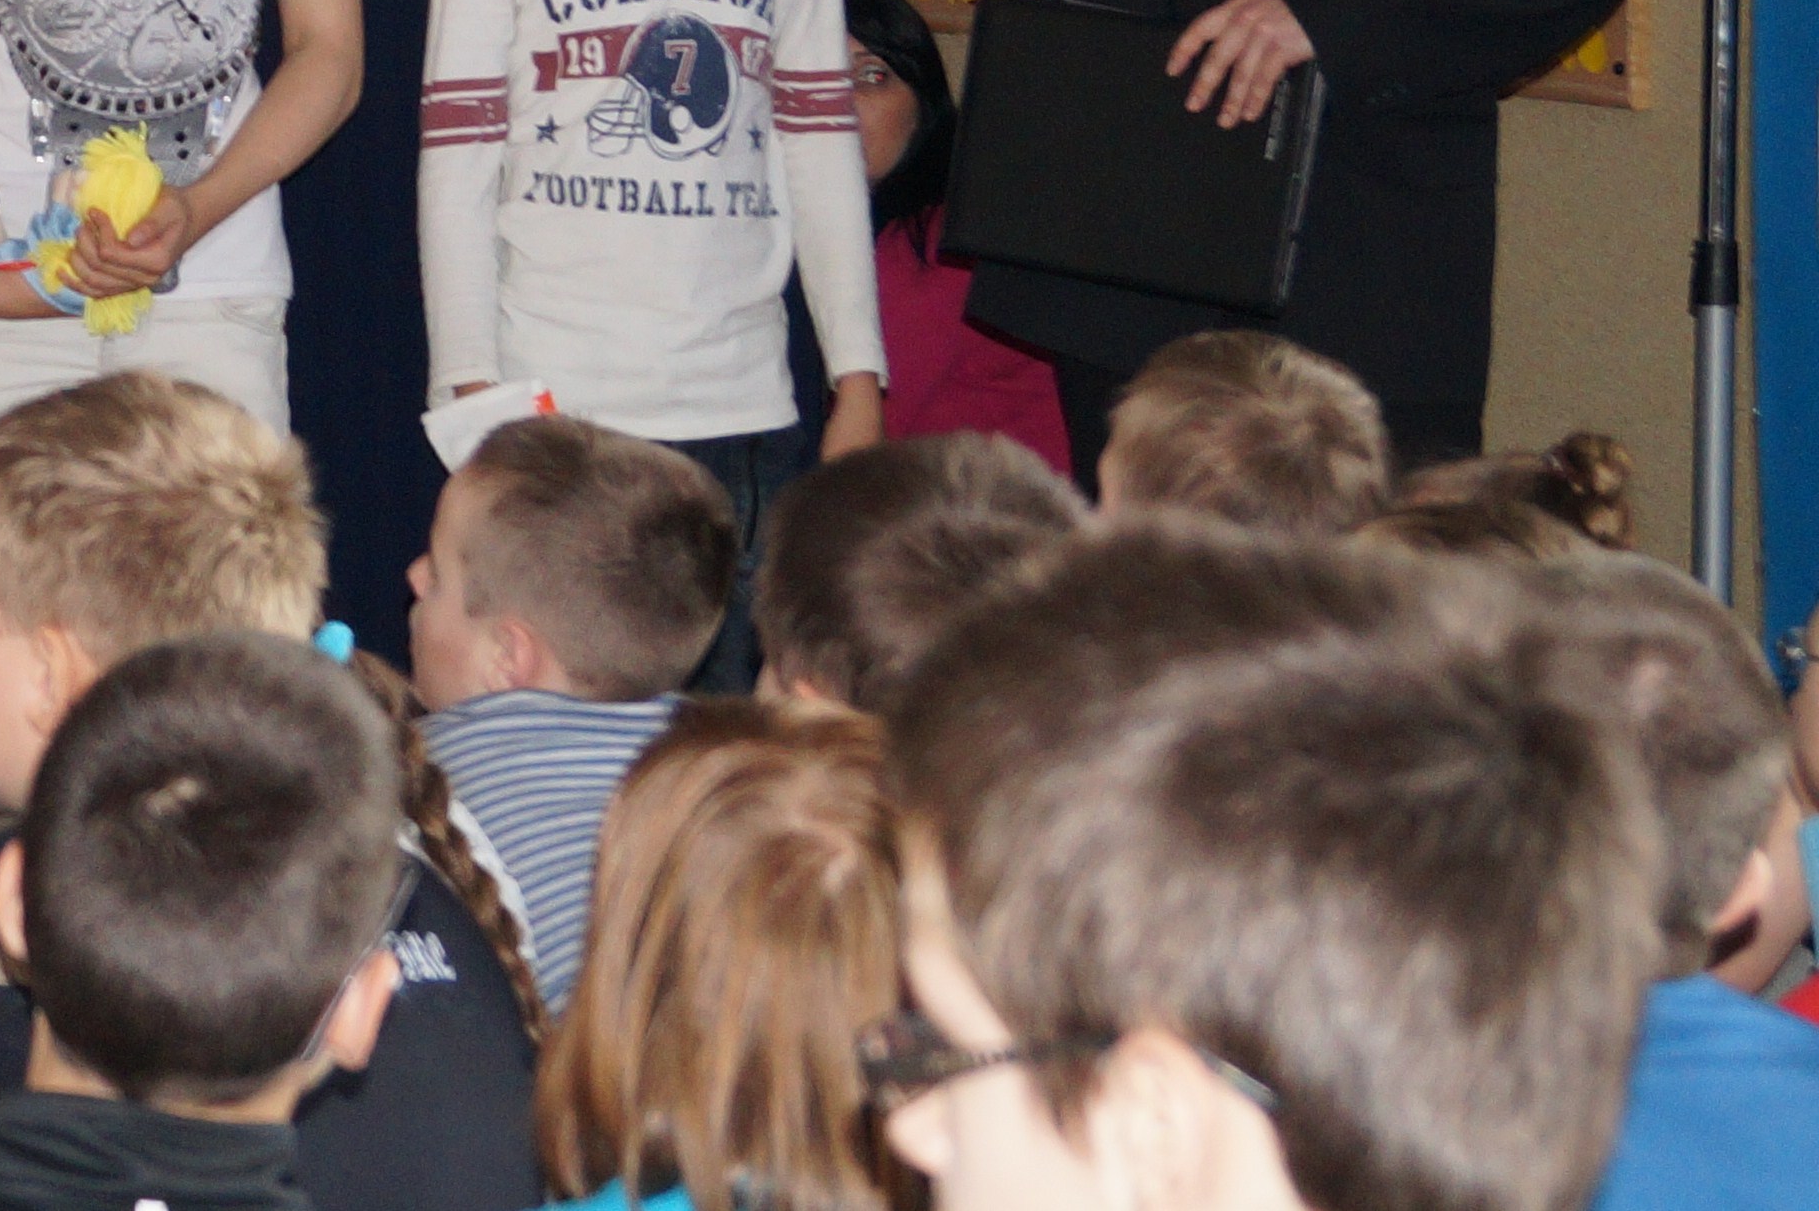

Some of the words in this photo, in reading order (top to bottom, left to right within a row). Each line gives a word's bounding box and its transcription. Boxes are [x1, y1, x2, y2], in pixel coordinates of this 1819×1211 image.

[564, 38, 608, 77] 19
[664, 38, 698, 96] 7
[522, 169, 717, 217] FOOTBALL
[724, 180, 781, 219] TEA
